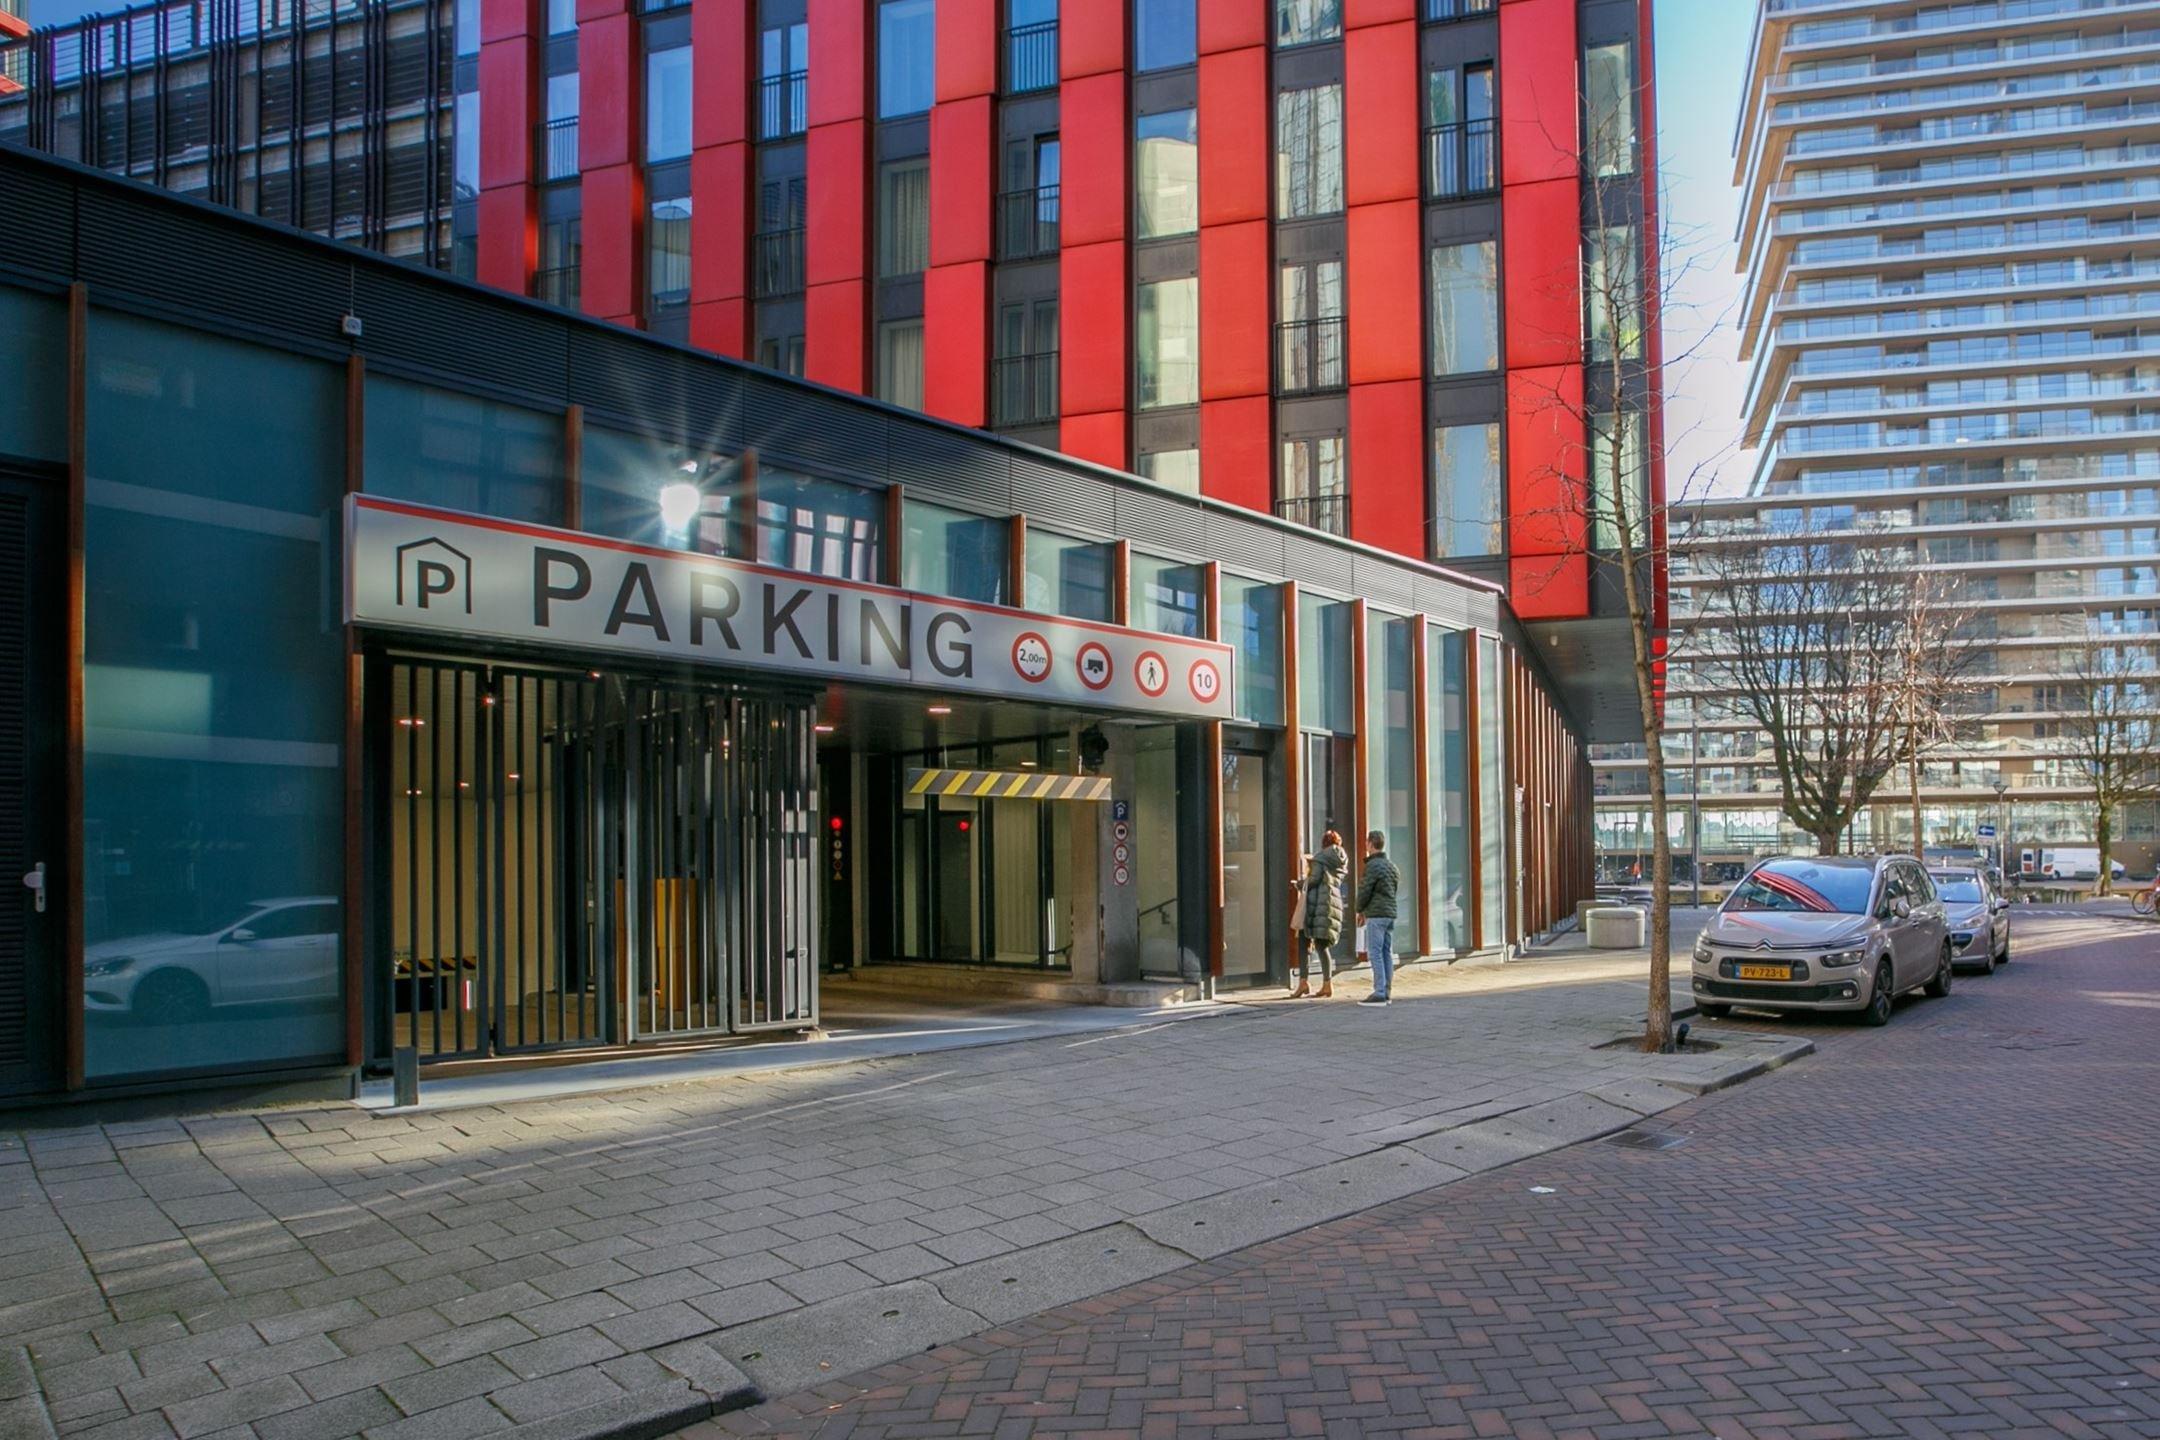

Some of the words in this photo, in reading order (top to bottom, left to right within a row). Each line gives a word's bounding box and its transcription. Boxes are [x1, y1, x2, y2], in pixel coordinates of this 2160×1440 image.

[417, 559, 455, 609] P
[534, 546, 974, 680] PARKING
[1197, 673, 1212, 689] 10
